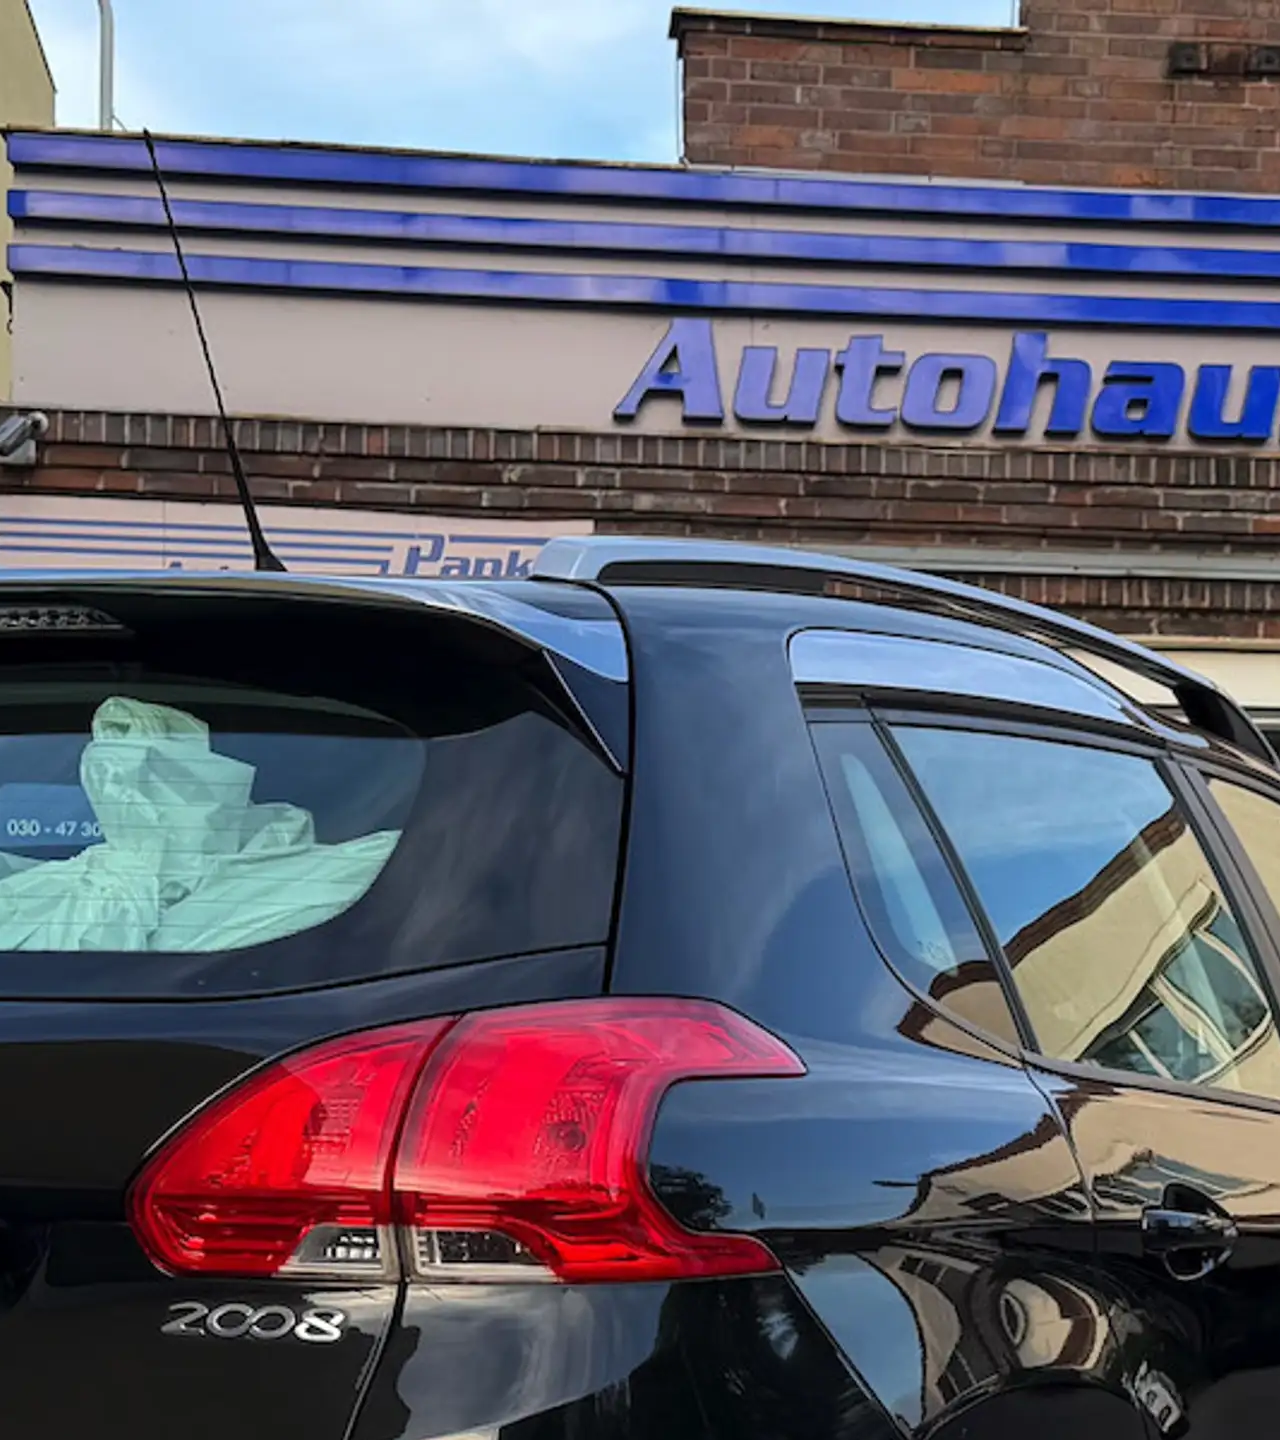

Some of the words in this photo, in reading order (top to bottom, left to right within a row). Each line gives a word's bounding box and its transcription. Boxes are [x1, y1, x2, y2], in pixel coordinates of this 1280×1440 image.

[402, 535, 533, 579] Pank
[6, 818, 41, 837] 030
[54, 820, 78, 837] 47
[160, 1301, 345, 1343] 2008
